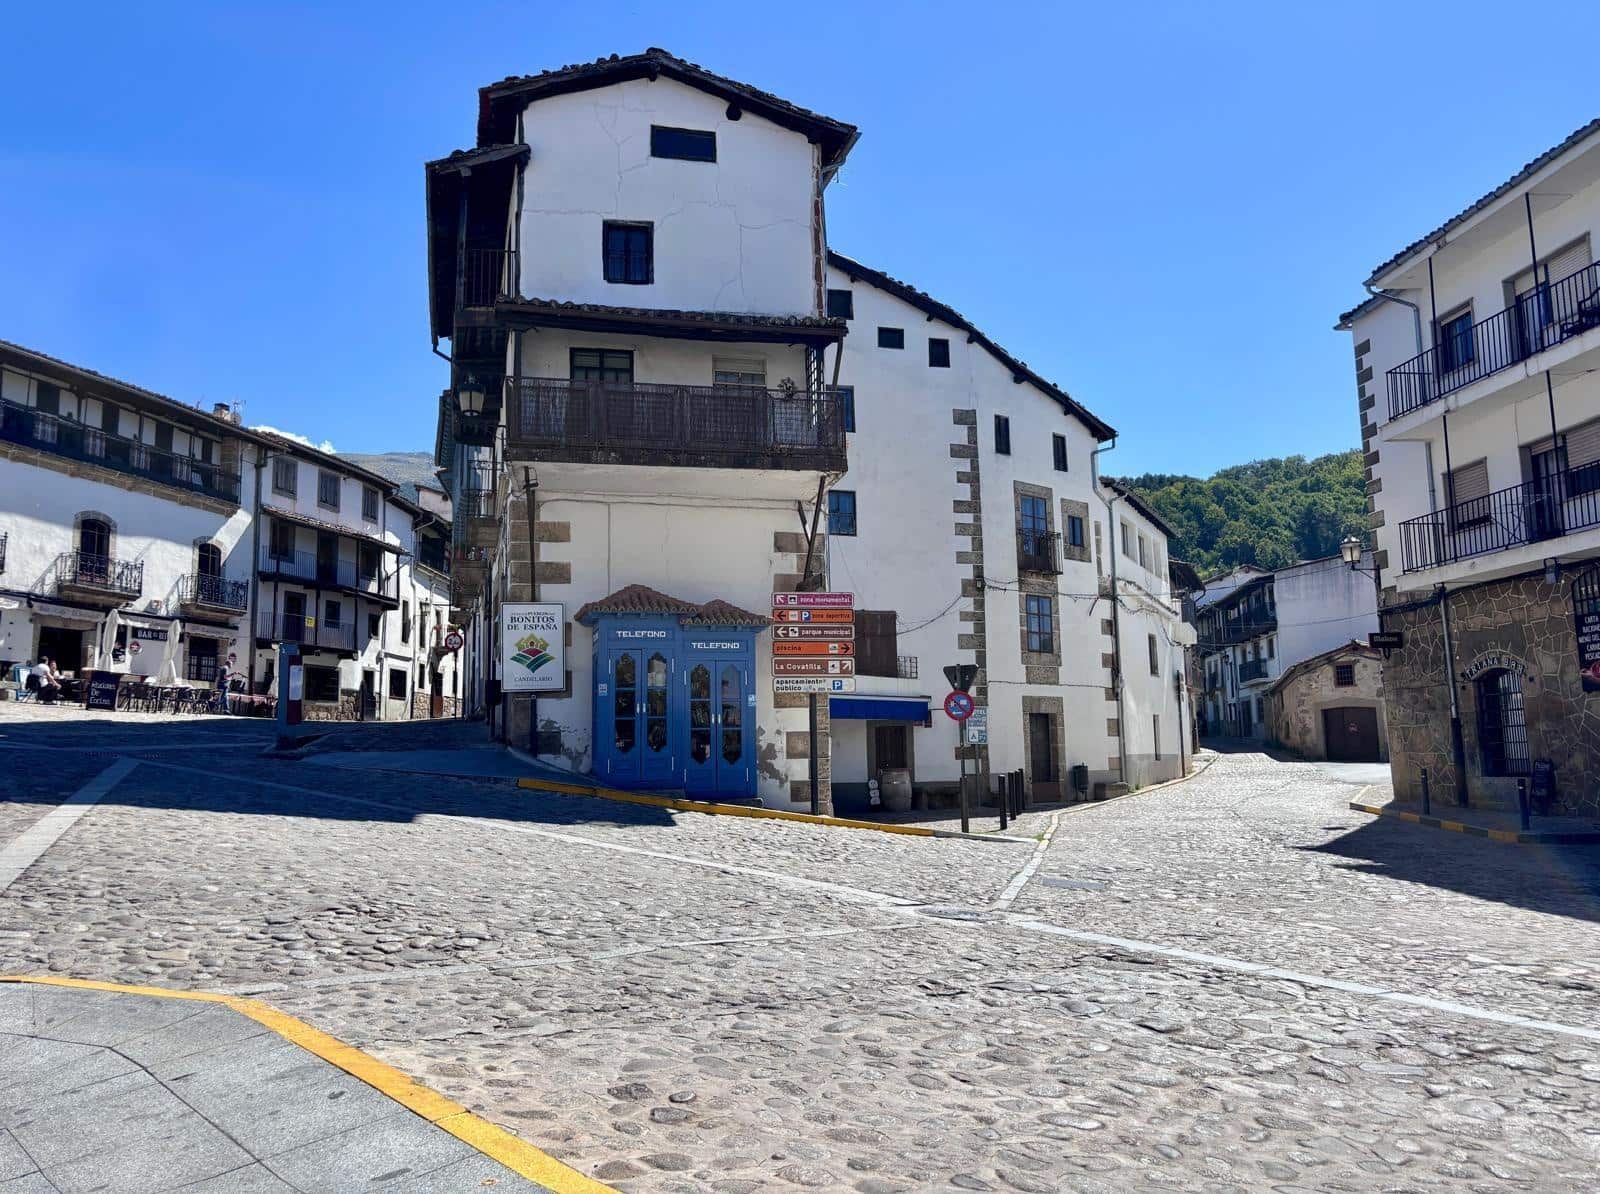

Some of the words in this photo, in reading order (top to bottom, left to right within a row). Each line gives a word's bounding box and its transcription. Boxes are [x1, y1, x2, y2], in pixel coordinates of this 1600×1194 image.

[510, 615, 555, 624] BONITOS
[523, 622, 558, 631] ESPAÑA
[137, 629, 152, 639] BAR
[616, 630, 667, 638] TELEFONO
[801, 629, 822, 637] parque
[823, 629, 851, 637] municipal
[776, 644, 802, 652] piscina
